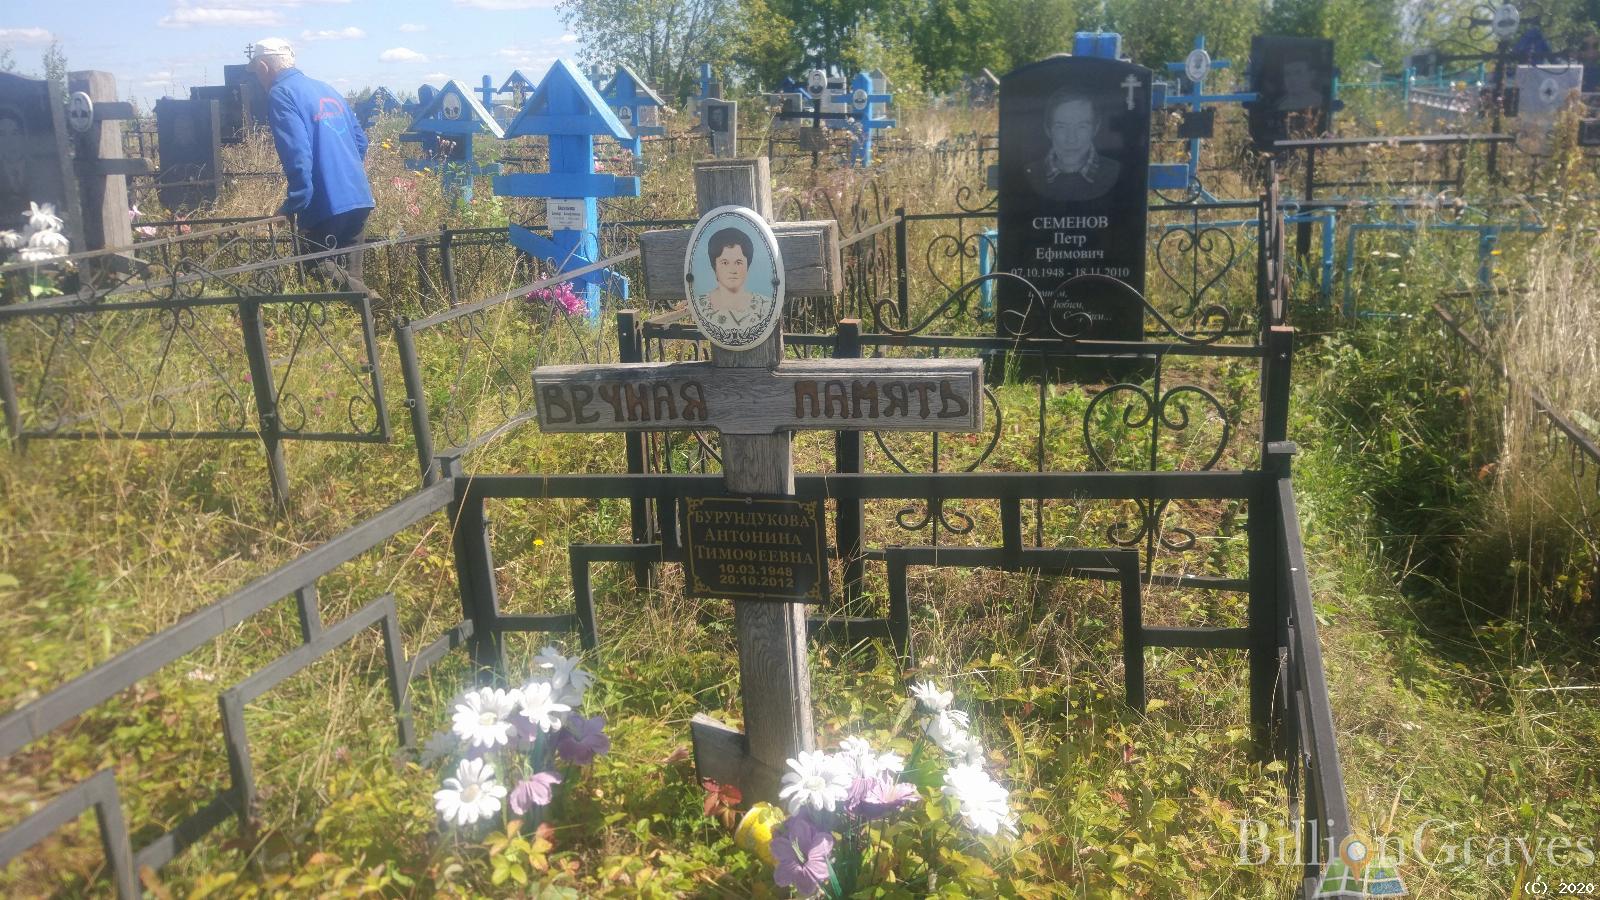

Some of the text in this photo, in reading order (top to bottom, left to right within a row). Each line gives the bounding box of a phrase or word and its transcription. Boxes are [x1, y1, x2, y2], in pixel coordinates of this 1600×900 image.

[1032, 216, 1109, 230] СЕМЕНОВ
[1053, 232, 1087, 247] Петр
[1035, 247, 1105, 262] Ефимович
[1011, 267, 1065, 278] 07.10.1948
[1075, 267, 1130, 278] 18112010
[793, 379, 969, 420] ПАМЯТЬ
[694, 510, 811, 528] БУРУНДУКОВА
[705, 527, 802, 545] АНТОНИНА
[694, 544, 815, 565] ТИМОФЕЕВНА
[719, 563, 793, 577] 10.03.1948
[719, 574, 794, 588] 20.10.2012
